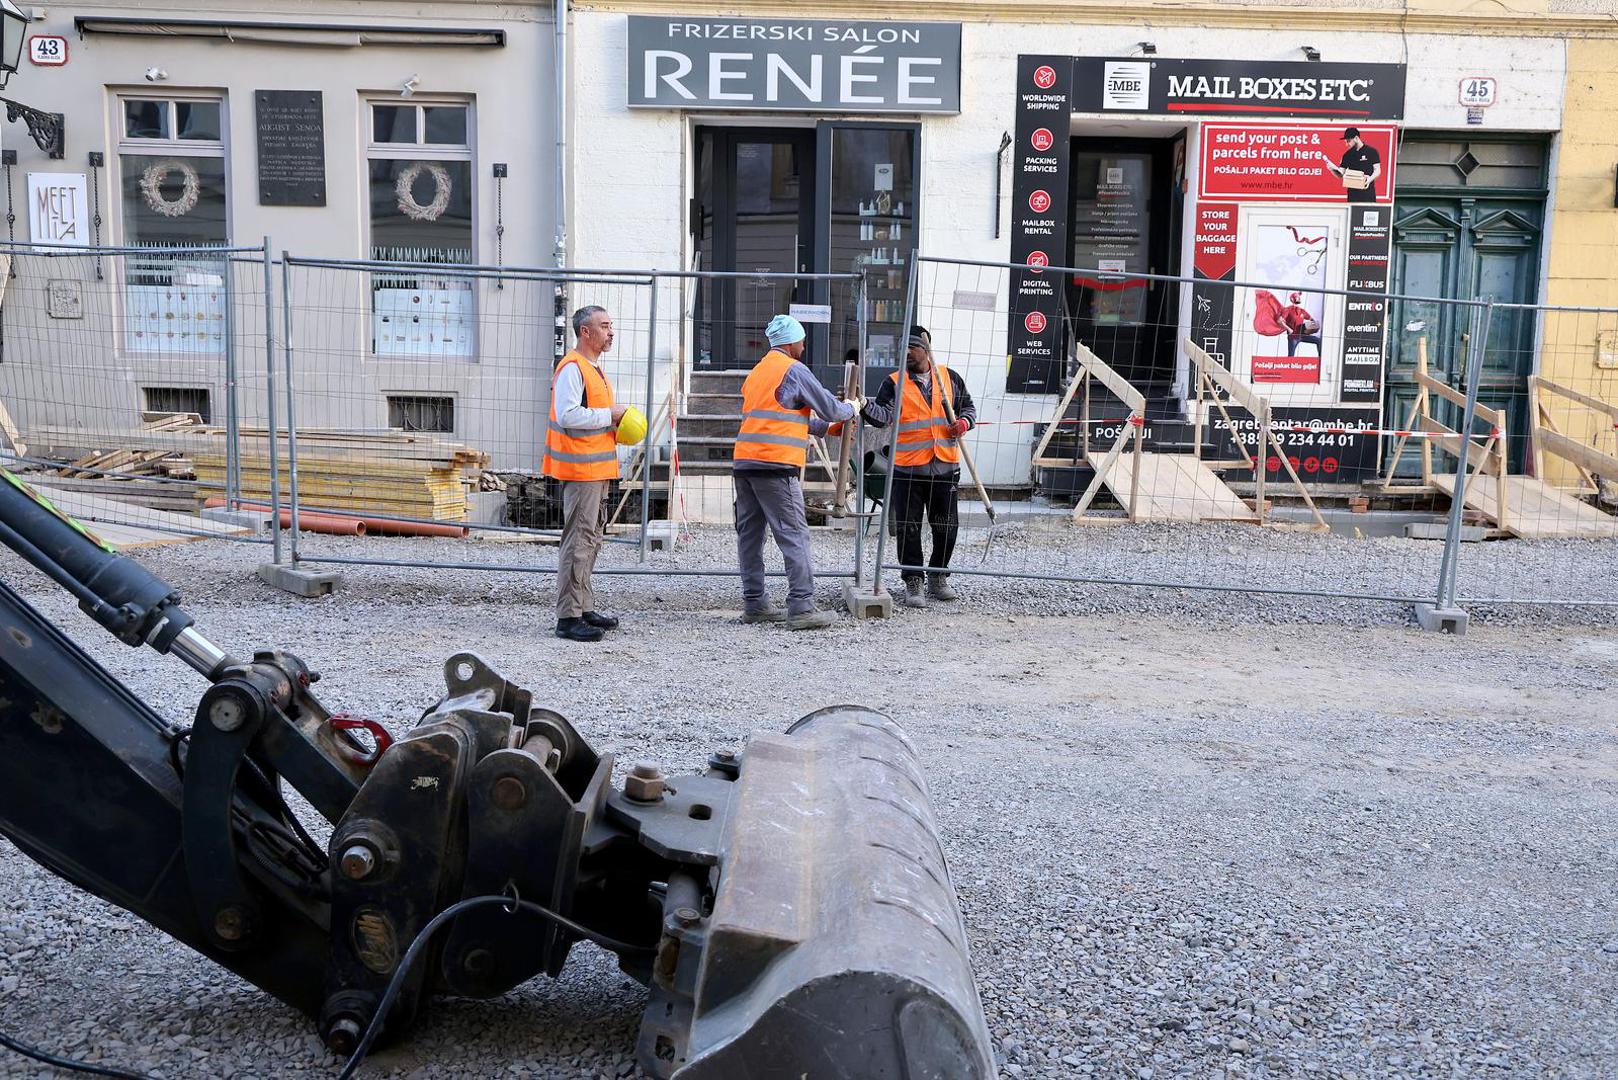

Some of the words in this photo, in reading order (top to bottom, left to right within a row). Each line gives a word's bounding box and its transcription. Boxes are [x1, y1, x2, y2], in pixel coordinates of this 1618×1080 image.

[668, 23, 813, 41] FRIZERSKI
[823, 26, 920, 44] SALON
[37, 39, 59, 55] 43
[644, 45, 942, 105] RENÉE
[1112, 80, 1142, 92] MBE
[1167, 75, 1236, 98] MAIL
[1238, 77, 1318, 100] BOXES
[1466, 79, 1489, 98] 45
[1022, 94, 1066, 102] WORLDWIDE
[1026, 102, 1060, 110] SHIPPING
[1215, 131, 1247, 143] send
[1248, 133, 1278, 146] your
[1280, 133, 1309, 146] post
[1311, 133, 1321, 144] &
[1212, 147, 1258, 160] parcels
[1260, 147, 1291, 159] from
[1293, 147, 1323, 160] here
[1025, 157, 1058, 165] PACKING
[1023, 165, 1058, 173] SERVICES
[1213, 164, 1249, 174] POŠALJI
[1249, 166, 1277, 175] PAKET
[1277, 167, 1298, 175] BILO
[1240, 180, 1294, 189] www.mbe.hr
[1201, 210, 1230, 219] STORE
[1022, 219, 1056, 227] MAILBOX
[1203, 222, 1228, 230] YOUR
[1024, 227, 1052, 235] RENTAL
[1196, 234, 1237, 243] BAGGAGE
[1203, 246, 1226, 254] HERE
[1022, 280, 1051, 288] DIGITAL
[1019, 287, 1053, 296] PRINTING
[1346, 324, 1378, 333] eventim
[1017, 347, 1051, 355] SERVICES
[1214, 418, 1374, 433] zagrebentar@mbe.hr
[1288, 433, 1314, 446] 234
[1317, 434, 1336, 447] 44
[1338, 434, 1355, 447] 01
